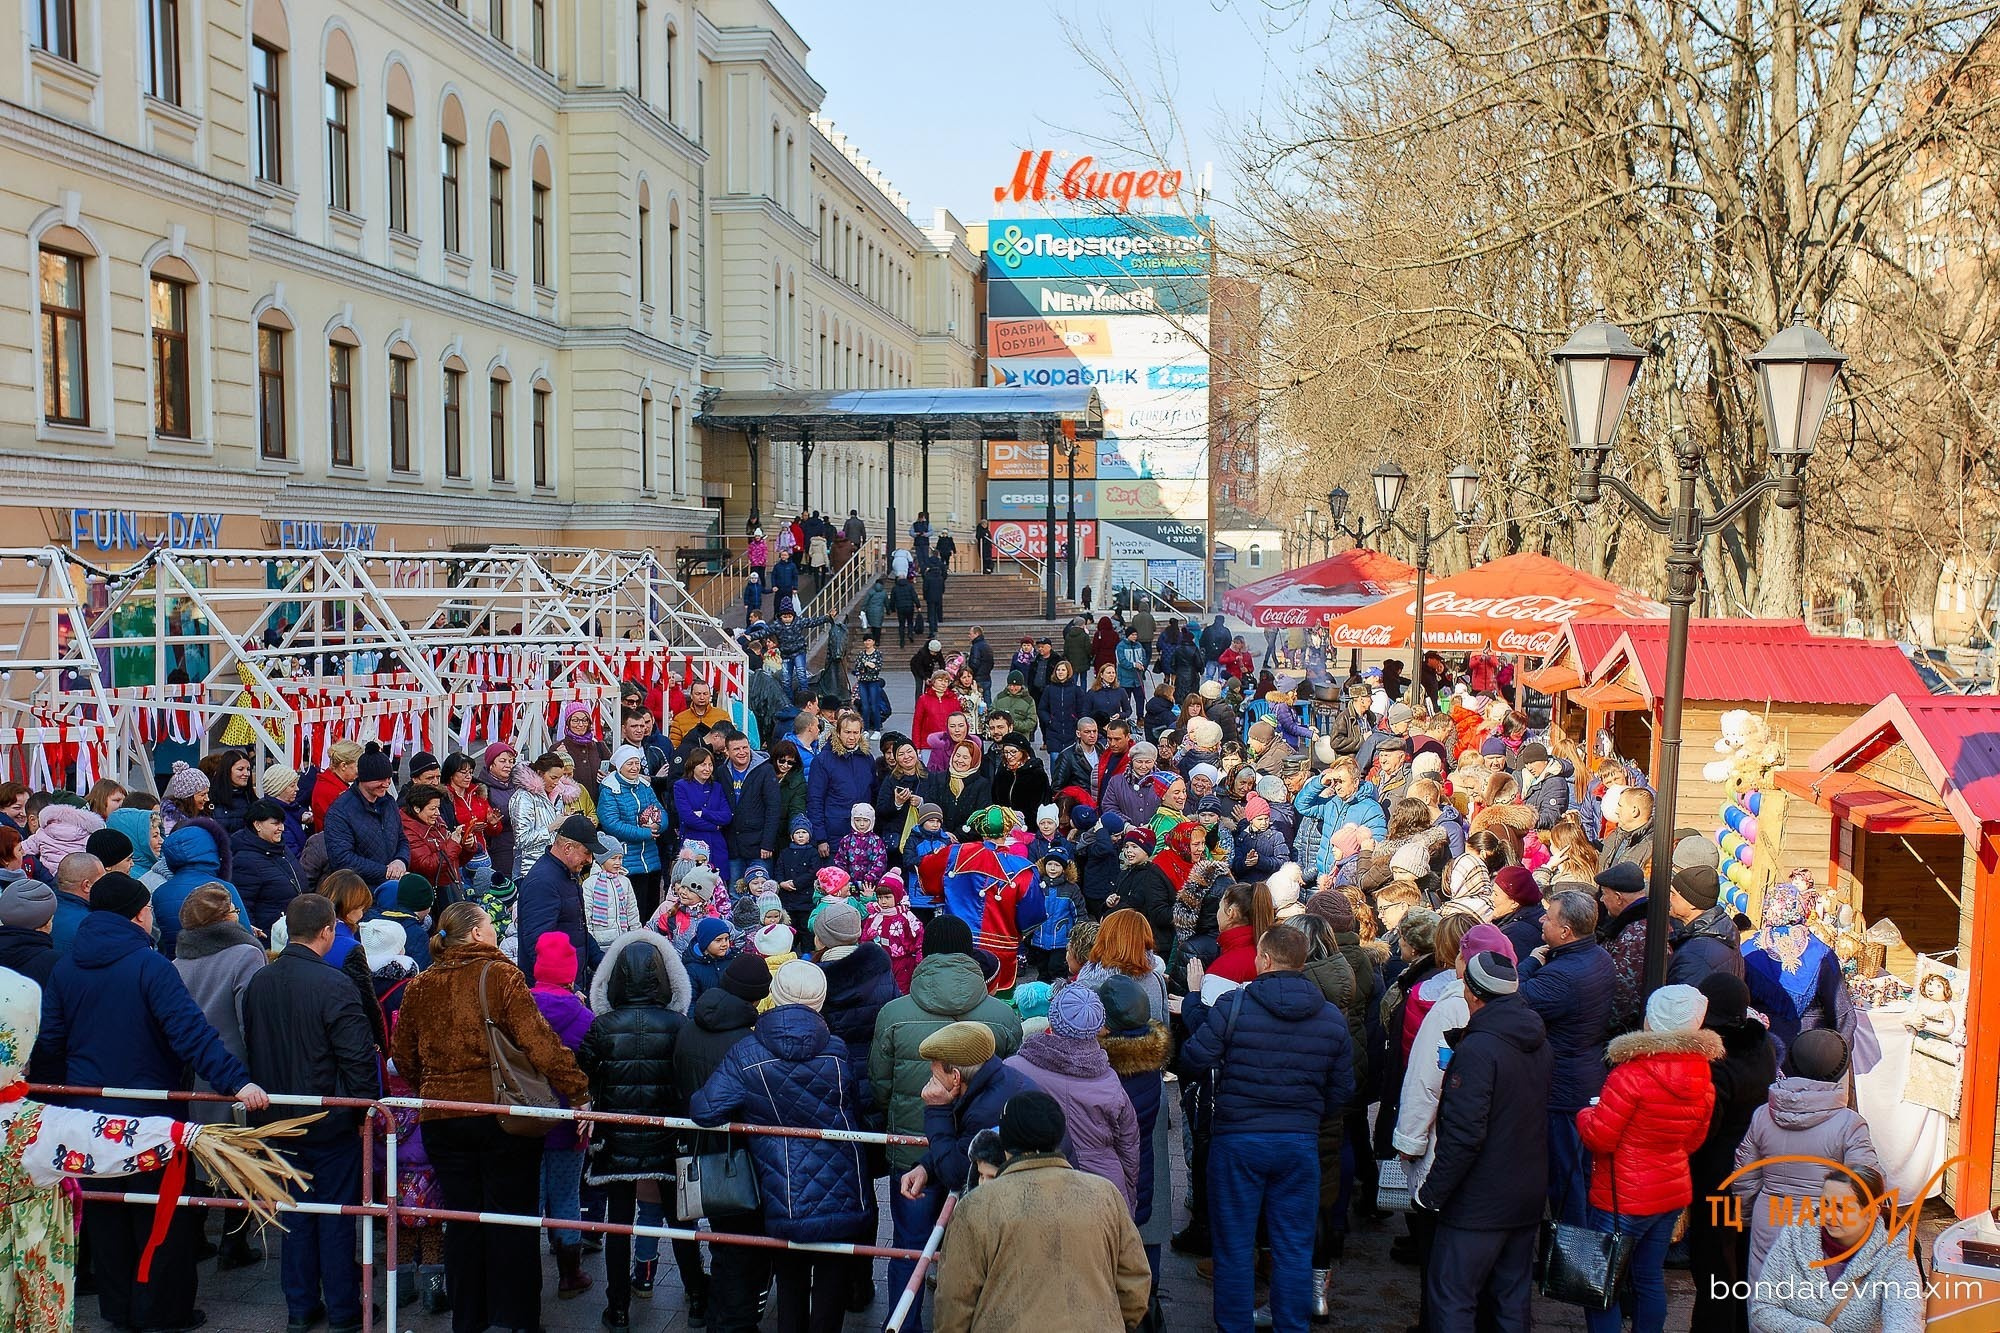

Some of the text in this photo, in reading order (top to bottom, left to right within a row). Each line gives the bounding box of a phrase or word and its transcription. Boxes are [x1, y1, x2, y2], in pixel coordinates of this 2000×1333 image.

[1002, 336, 1046, 350] ОБУВИ
[71, 509, 223, 551] FUN DAY
[280, 520, 377, 551] FUN DAY
[1157, 525, 1204, 535] MANGO
[1174, 535, 1198, 544] ЭТАЖ
[1260, 608, 1309, 625] Coca-Cola
[1406, 591, 1596, 623] Coca-Cola
[1334, 624, 1395, 645] Coca-Cola
